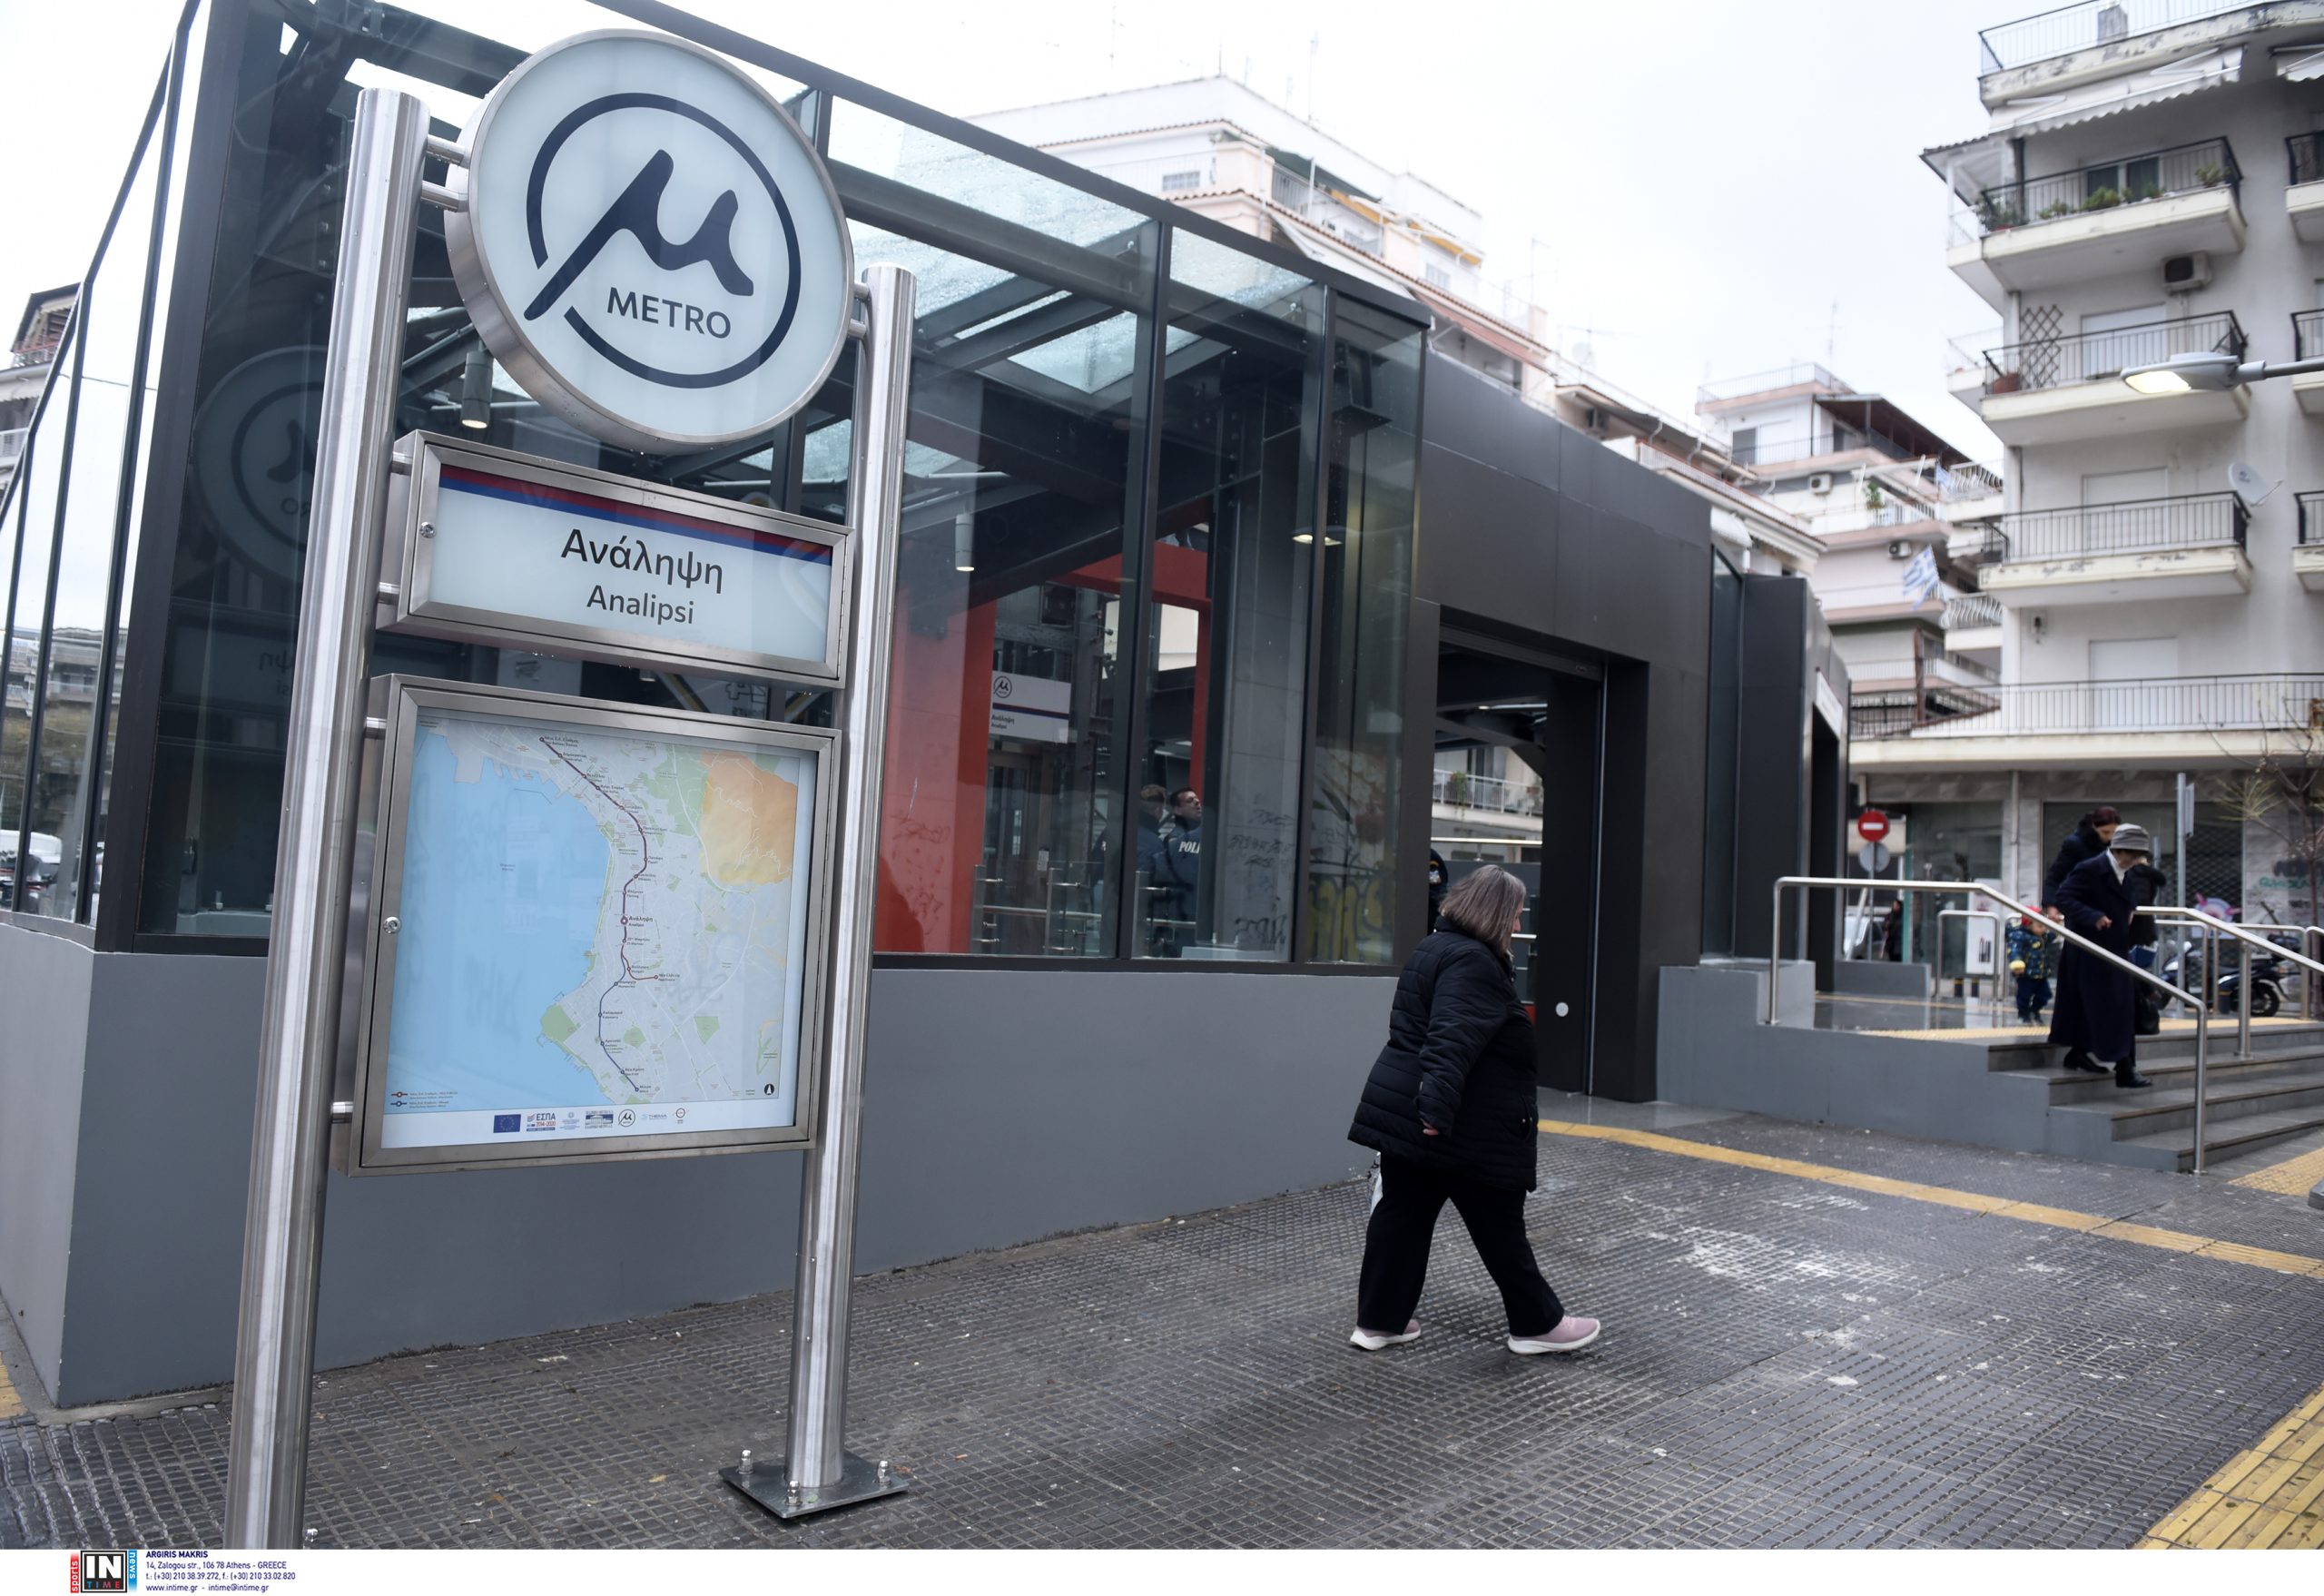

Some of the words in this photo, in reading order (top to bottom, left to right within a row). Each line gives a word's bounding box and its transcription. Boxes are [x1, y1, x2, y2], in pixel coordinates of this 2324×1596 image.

[606, 286, 732, 339] METRO
[560, 527, 724, 594] Ανάληψη
[586, 584, 694, 625] Analipsi
[536, 1112, 556, 1121] ΕΣΠΑ
